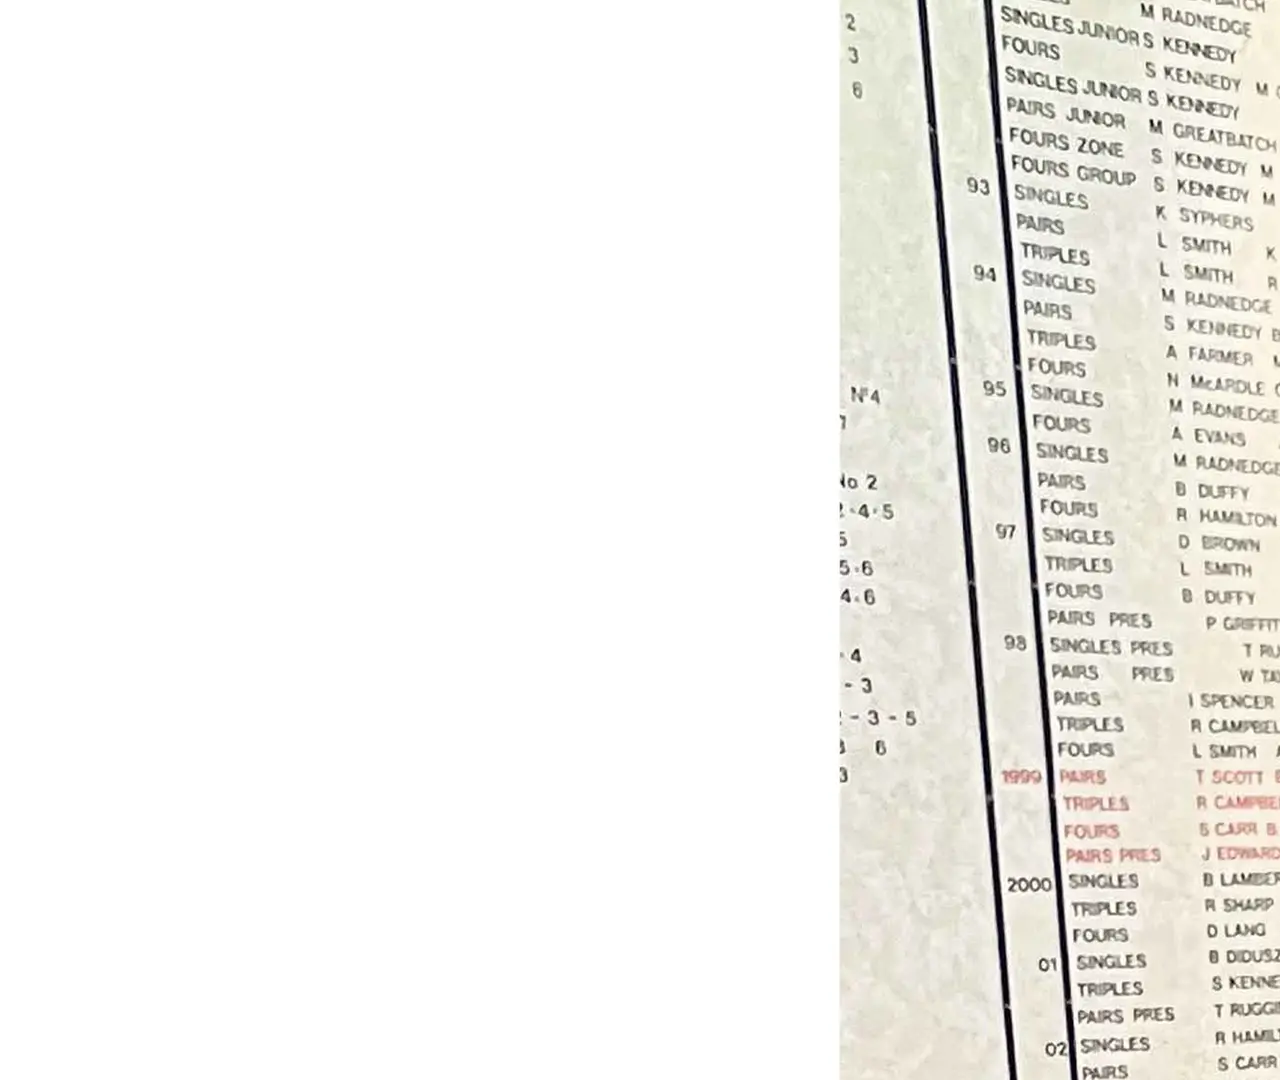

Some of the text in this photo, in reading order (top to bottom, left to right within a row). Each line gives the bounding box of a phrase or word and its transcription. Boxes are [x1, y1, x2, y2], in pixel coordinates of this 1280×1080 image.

[845, 13, 856, 31] 2
[1001, 6, 1074, 34] SINGLES
[1078, 20, 1140, 46] JUNIOR
[1163, 36, 1236, 64] KENNEDY
[848, 46, 859, 64] 3
[852, 82, 862, 99] 6
[967, 177, 989, 195] 93
[1015, 185, 1088, 210] SINGLES
[1180, 207, 1254, 232] SYPHERS
[1017, 214, 1065, 235] PAIRS
[1182, 236, 1231, 256] SMITH
[974, 265, 996, 281] 94
[1023, 270, 1095, 294] SINGLES
[1185, 291, 1272, 314] RADNEDGE
[1024, 300, 1072, 320] PAIRS
[1187, 319, 1262, 340] KENNEDY
[983, 380, 1006, 396] 95
[1032, 384, 1103, 408] SINGLES
[1193, 401, 1280, 424] RADNEDGE
[988, 437, 1010, 453] 96
[1037, 443, 1108, 464] SINGLES
[1038, 473, 1086, 491] PAIRS
[1198, 483, 1249, 500] DUFFY
[996, 523, 1015, 539] 97
[1043, 528, 1114, 546] SINGLES
[1004, 635, 1026, 650] 98
[1051, 637, 1121, 655] SINGLES
[1131, 641, 1173, 656] PRES
[1052, 665, 1099, 680] PAIRS
[1132, 666, 1174, 682] PRES
[1054, 691, 1101, 707] PAIRS
[1200, 693, 1274, 710] SPENCER
[1008, 877, 1051, 892] 2000
[1069, 873, 1139, 889] SINGLES
[1039, 958, 1056, 972] 01
[1078, 954, 1147, 970] SINGLES
[1078, 981, 1143, 996] TRIPLES
[1078, 1009, 1124, 1024] PAIRS
[1133, 1007, 1175, 1022] PRES
[1045, 1042, 1067, 1056] 02
[1081, 1037, 1150, 1053] SINGLES
[1083, 1065, 1128, 1080] PAIRS
[1235, 1055, 1277, 1070] CARR
